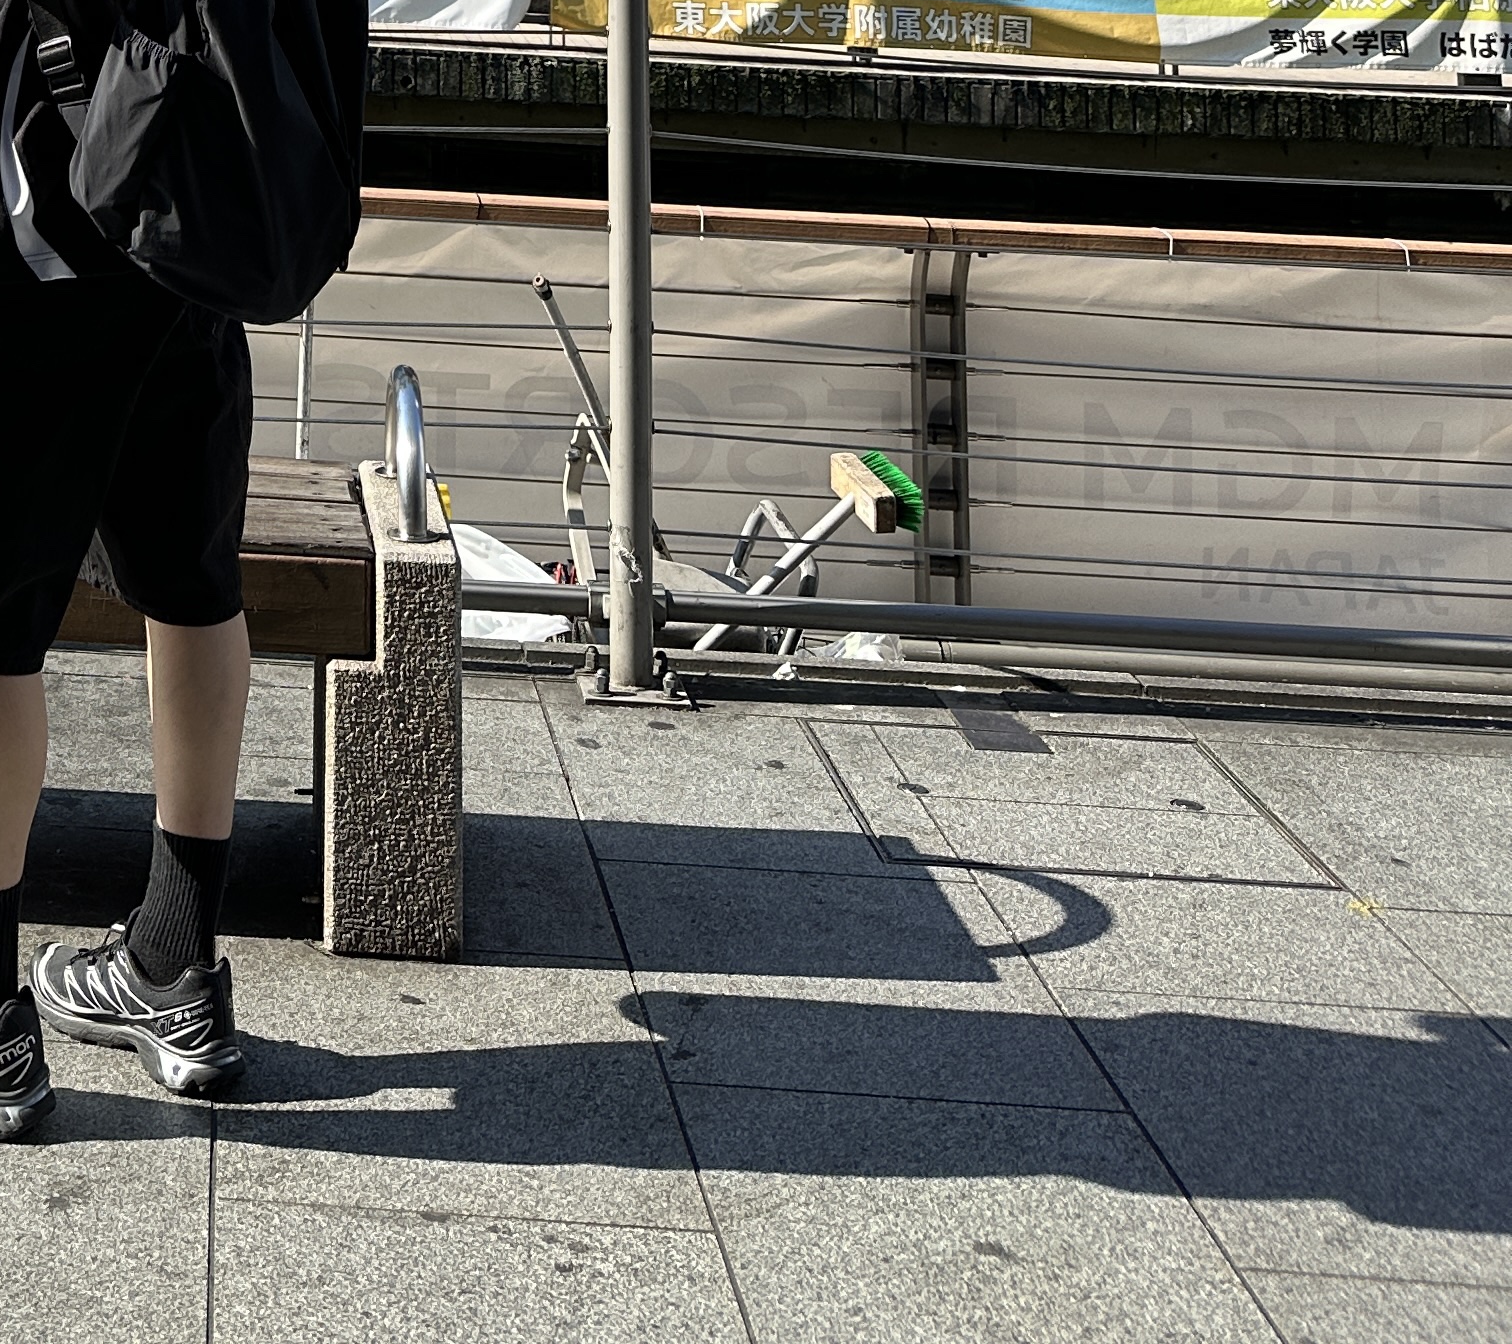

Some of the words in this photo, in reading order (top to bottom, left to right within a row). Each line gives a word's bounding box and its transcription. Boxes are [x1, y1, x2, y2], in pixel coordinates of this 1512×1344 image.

[671, 0, 1034, 50] 東大阪大学附属幼稚園
[1268, 28, 1410, 58] 夢輝く学園
